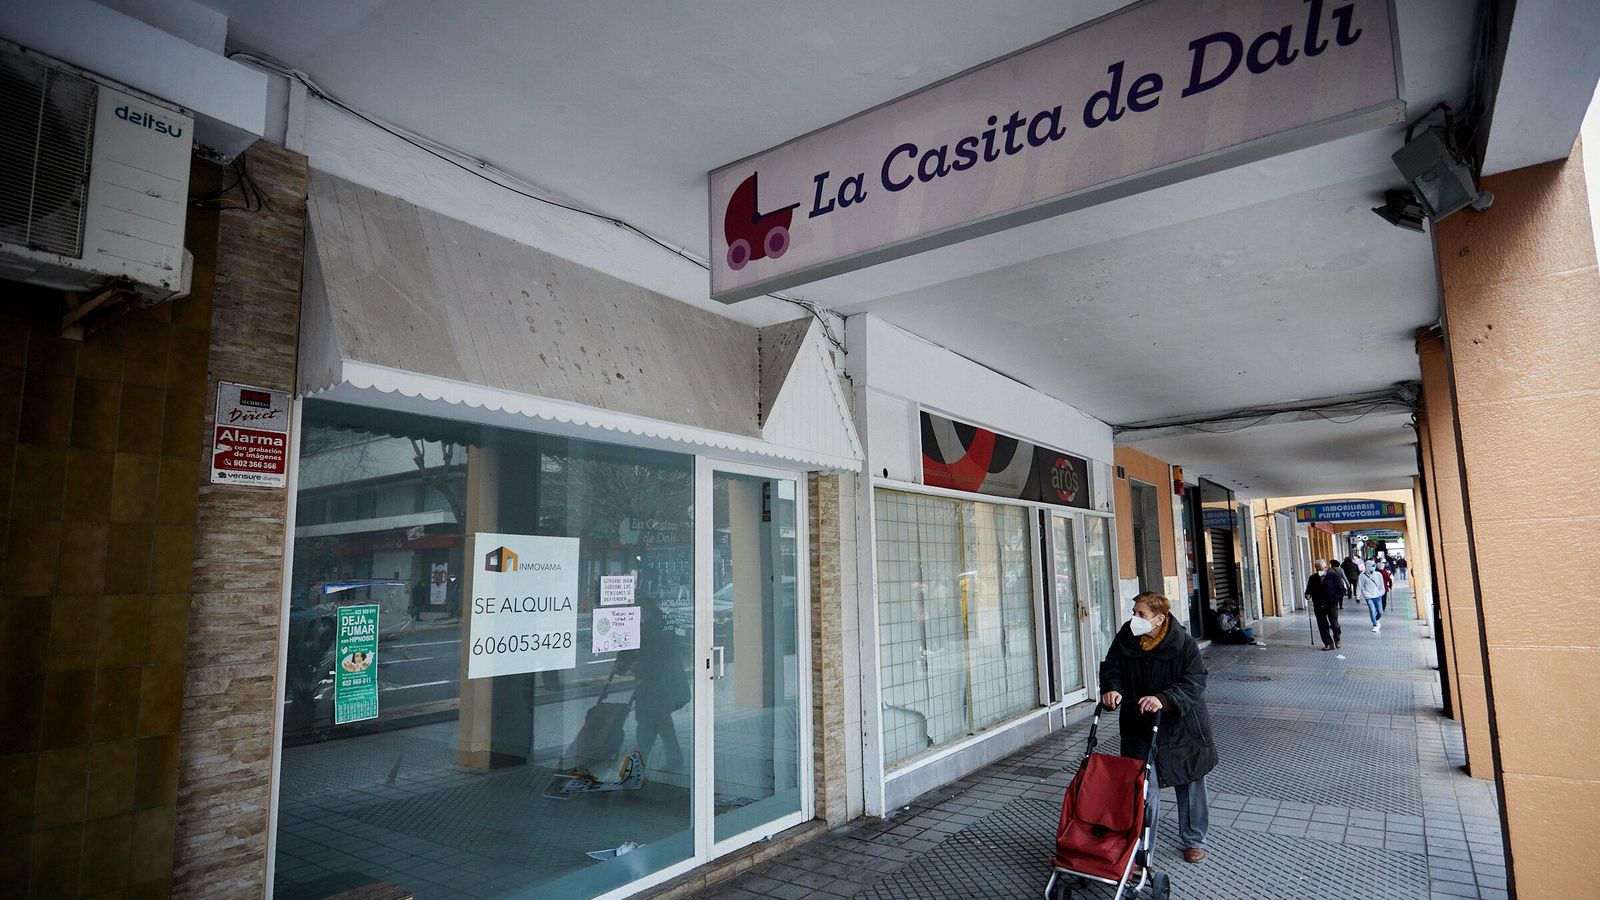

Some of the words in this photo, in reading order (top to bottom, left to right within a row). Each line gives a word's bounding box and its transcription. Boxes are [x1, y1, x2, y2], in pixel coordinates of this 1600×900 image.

[114, 106, 182, 138] daitsu
[808, 171, 867, 219] La
[881, 105, 1066, 192] Casita
[1083, 60, 1163, 128] de
[228, 408, 283, 423] Direct
[219, 430, 283, 446] Alarma
[246, 452, 282, 461] imágenes
[248, 446, 282, 454] grabación
[1318, 511, 1341, 519] PLAYA
[1341, 510, 1381, 518] VICTORIA
[519, 562, 561, 571] INMOVAMA
[474, 598, 496, 615] SE
[500, 596, 572, 613] ALQUILA
[341, 614, 367, 626] DEJA
[341, 624, 375, 637] FUMAR
[472, 631, 572, 656] 606053428
